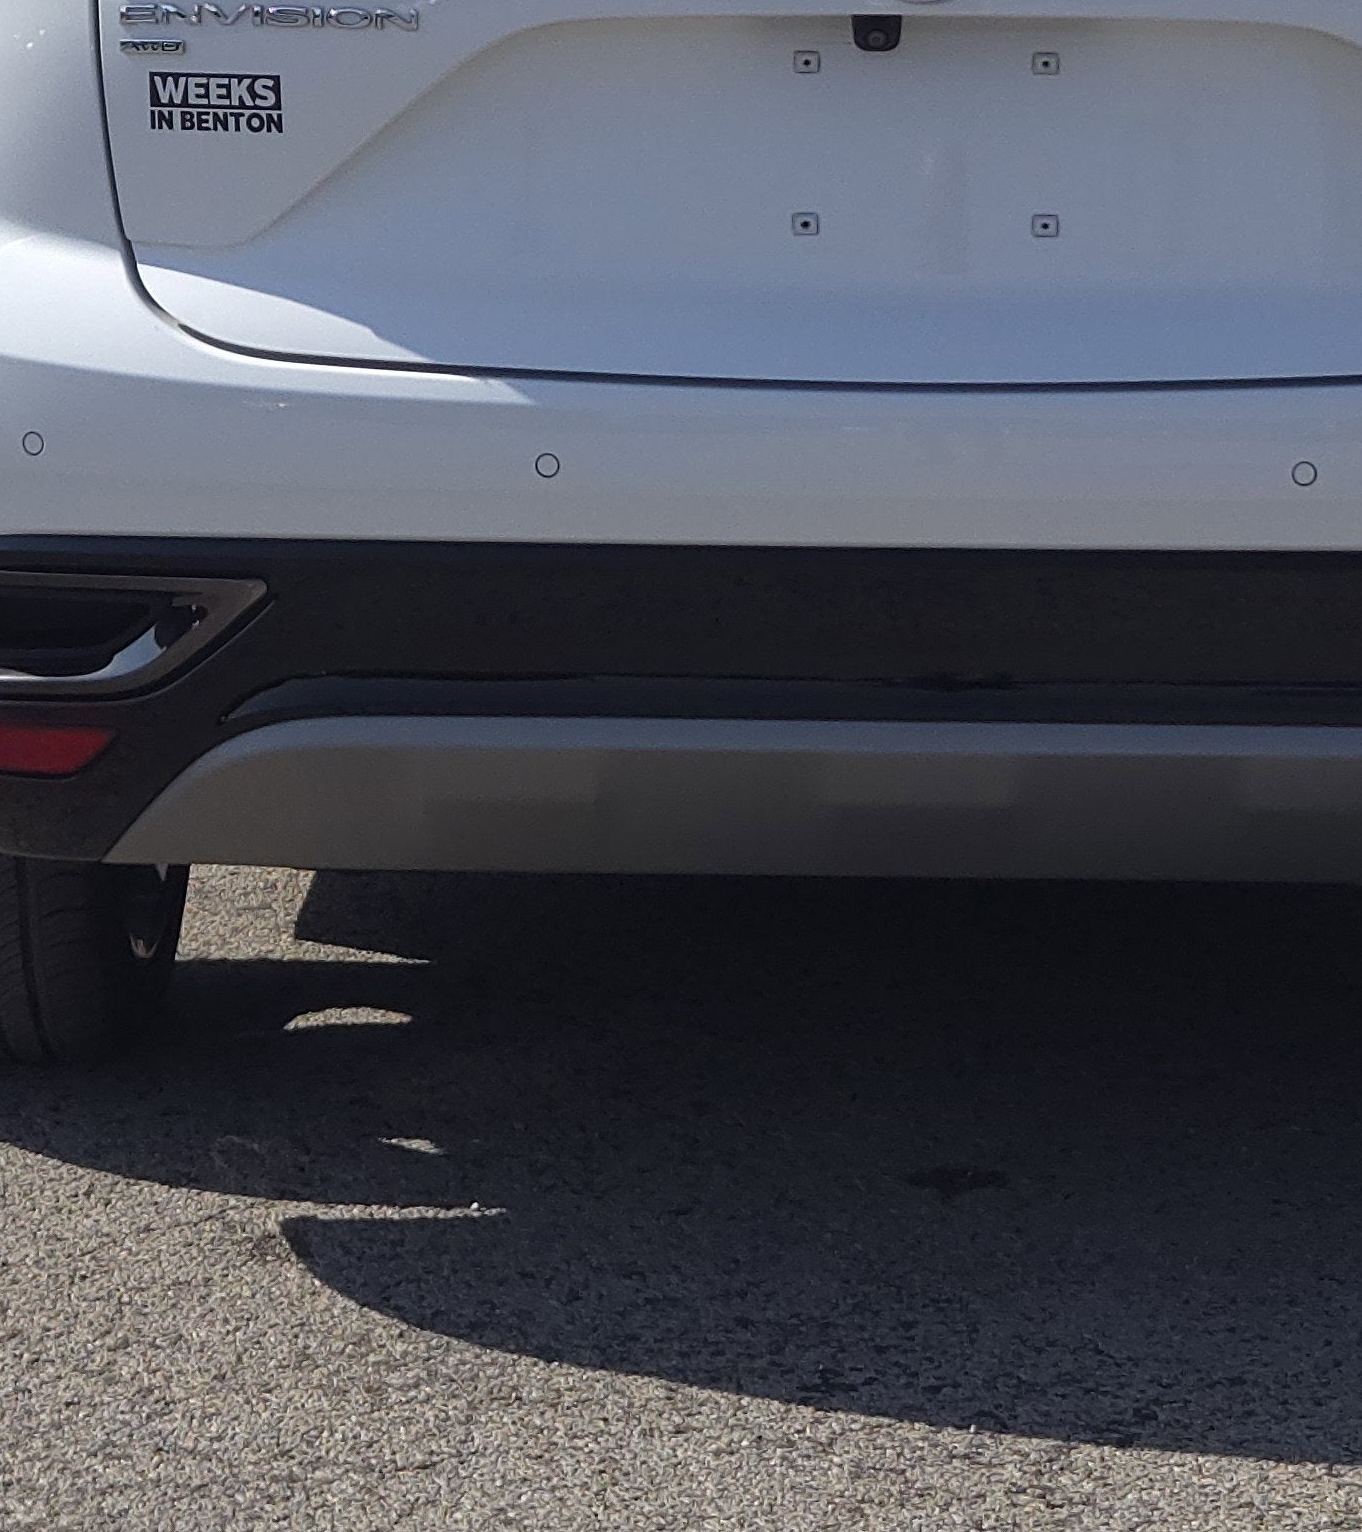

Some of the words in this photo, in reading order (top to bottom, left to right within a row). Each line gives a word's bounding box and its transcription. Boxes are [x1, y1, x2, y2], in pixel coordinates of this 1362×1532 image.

[119, 2, 419, 32] ENVISION
[153, 75, 277, 108] WEEKS
[150, 109, 174, 130] IN
[180, 110, 284, 134] BENTON
